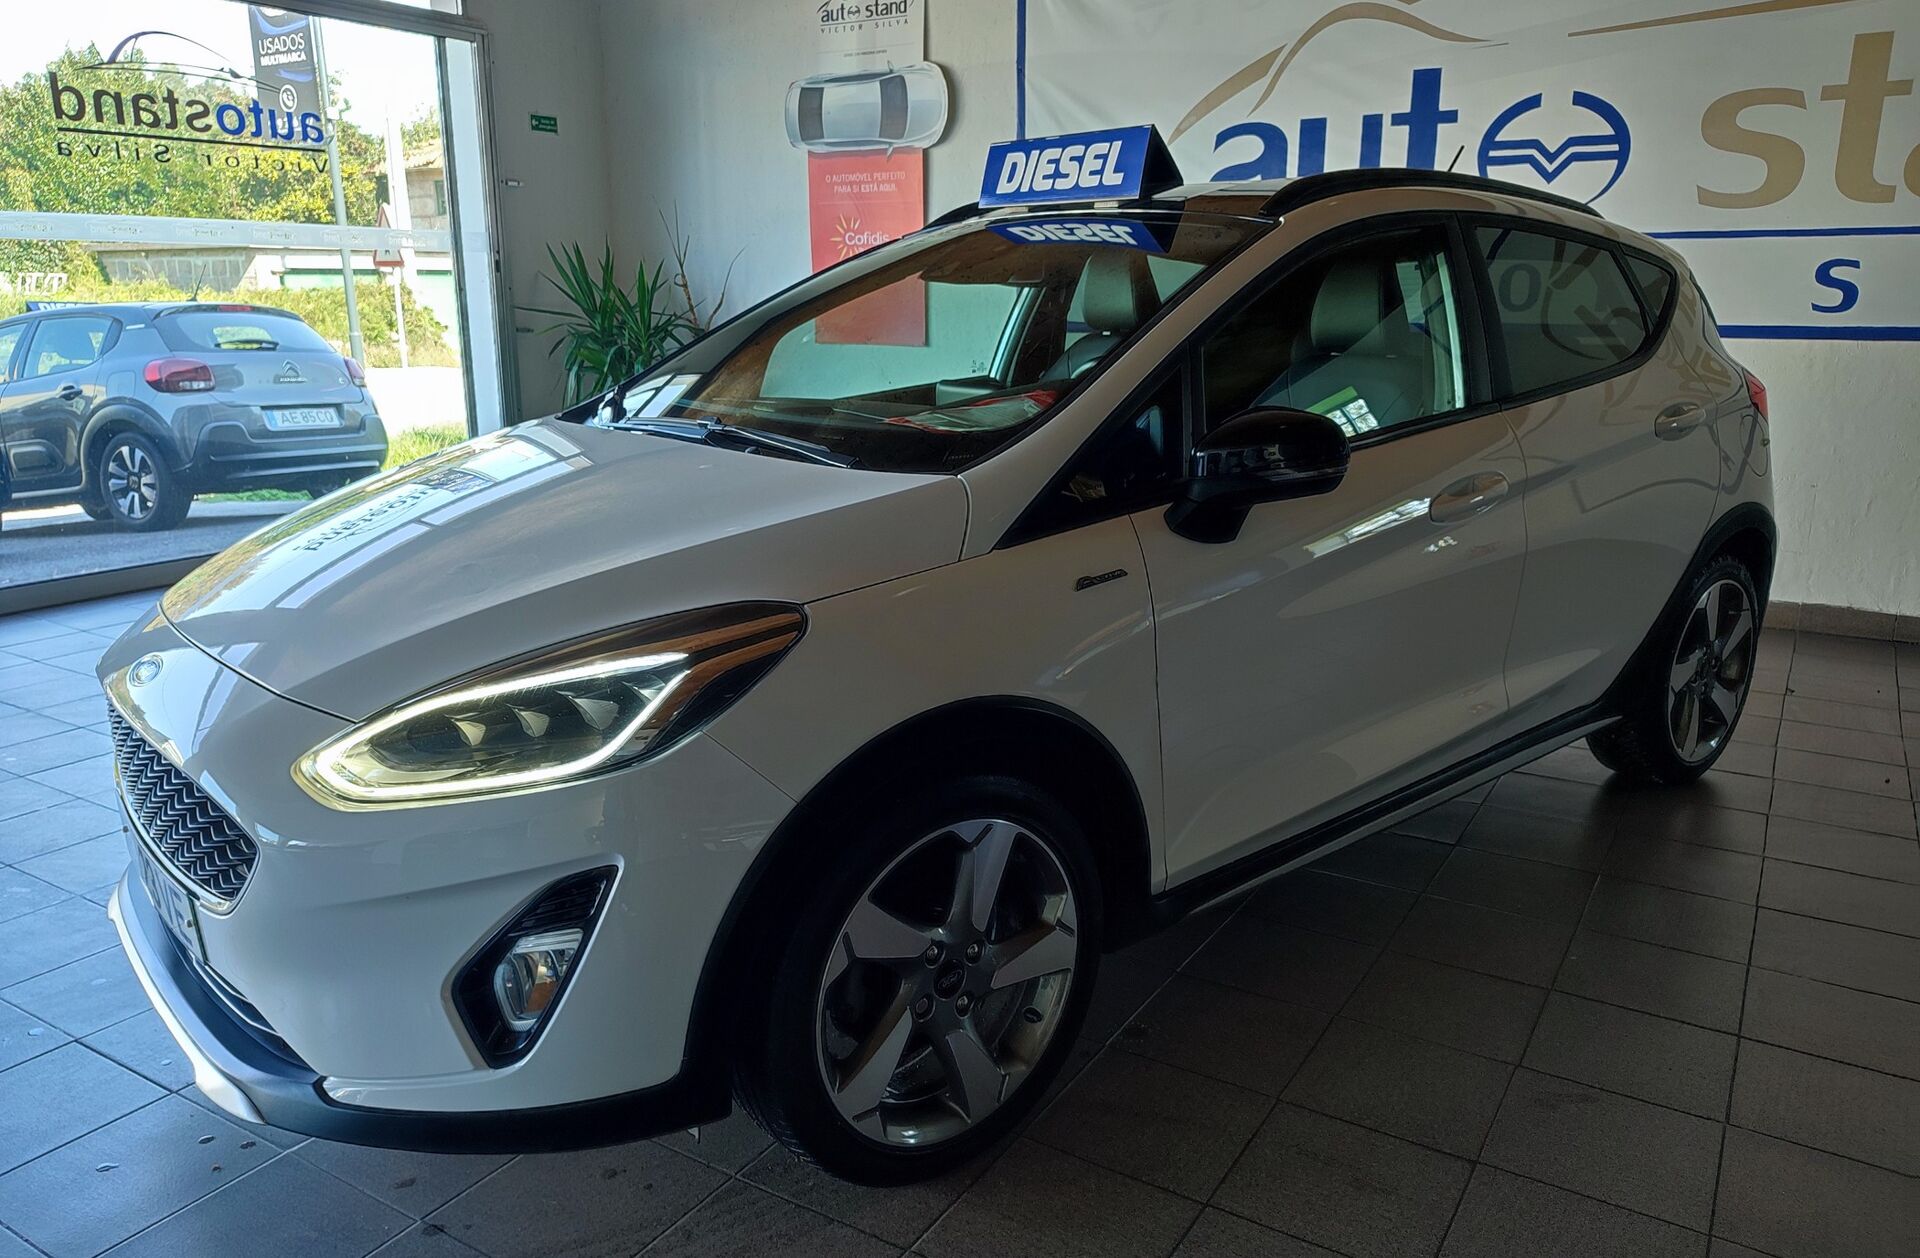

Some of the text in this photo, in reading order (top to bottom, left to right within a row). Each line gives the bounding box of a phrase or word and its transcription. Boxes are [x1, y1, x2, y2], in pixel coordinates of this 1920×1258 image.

[865, 0, 907, 18] stand
[821, 19, 909, 34] VICTOR SILVA
[258, 32, 305, 54] USADOS
[260, 51, 306, 66] MULTIMARCA
[1696, 31, 1920, 209] st
[996, 140, 1124, 194] DIESEL
[825, 171, 906, 183] O AUTOMÓVEL PERFEITO
[834, 185, 851, 193] PARA
[861, 182, 878, 192] ESTÁ
[845, 231, 890, 245] Cofidis
